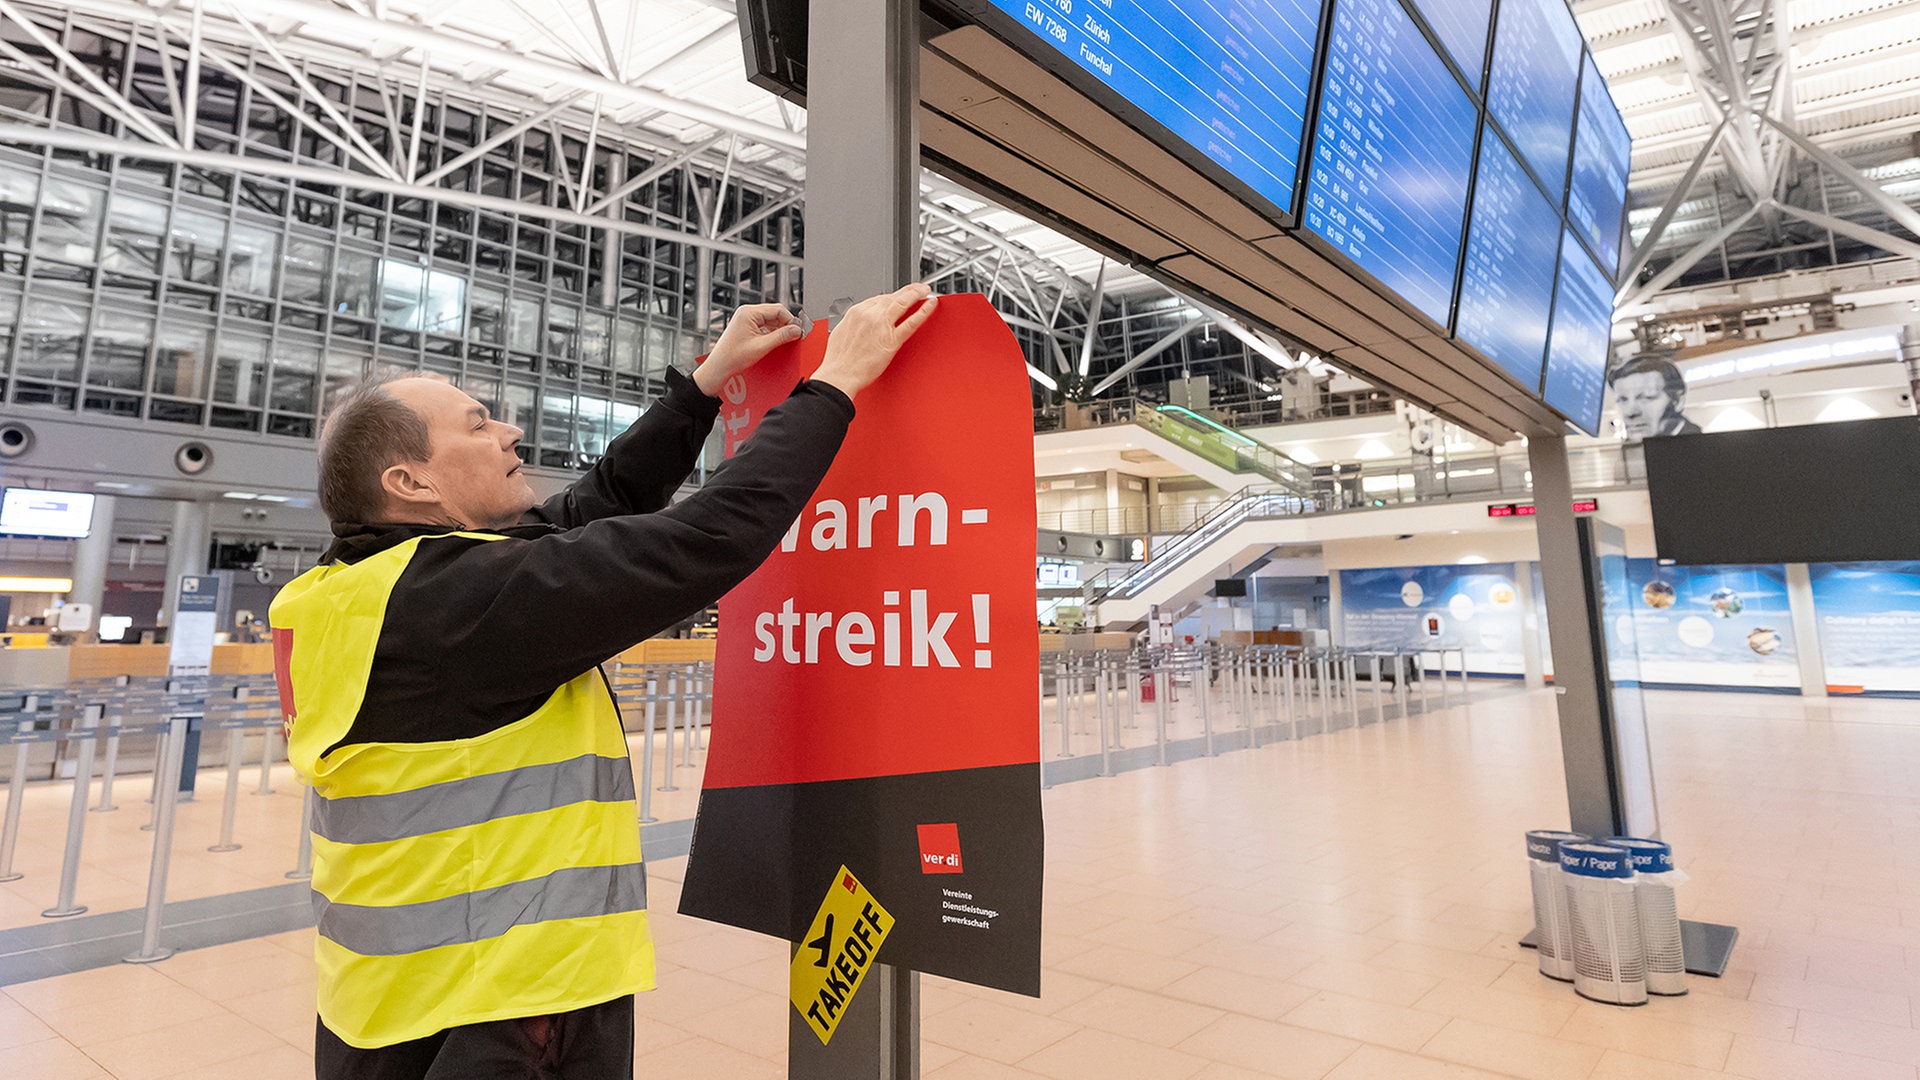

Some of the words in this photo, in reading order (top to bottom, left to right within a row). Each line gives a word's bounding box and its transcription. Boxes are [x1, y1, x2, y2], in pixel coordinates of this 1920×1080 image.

[1083, 13, 1111, 45] Zürich
[1024, 2, 1045, 26] EW
[1045, 16, 1068, 43] 7268
[1080, 42, 1113, 76] Funchal
[754, 588, 993, 669] streik!
[922, 853, 959, 867] ver.di
[1590, 857, 1618, 872] Paper
[942, 888, 973, 901] Vereinte
[942, 900, 999, 918] Dienstleistungs-
[942, 914, 989, 929] gewerkschaft
[807, 900, 883, 1031] TAKEOFF
